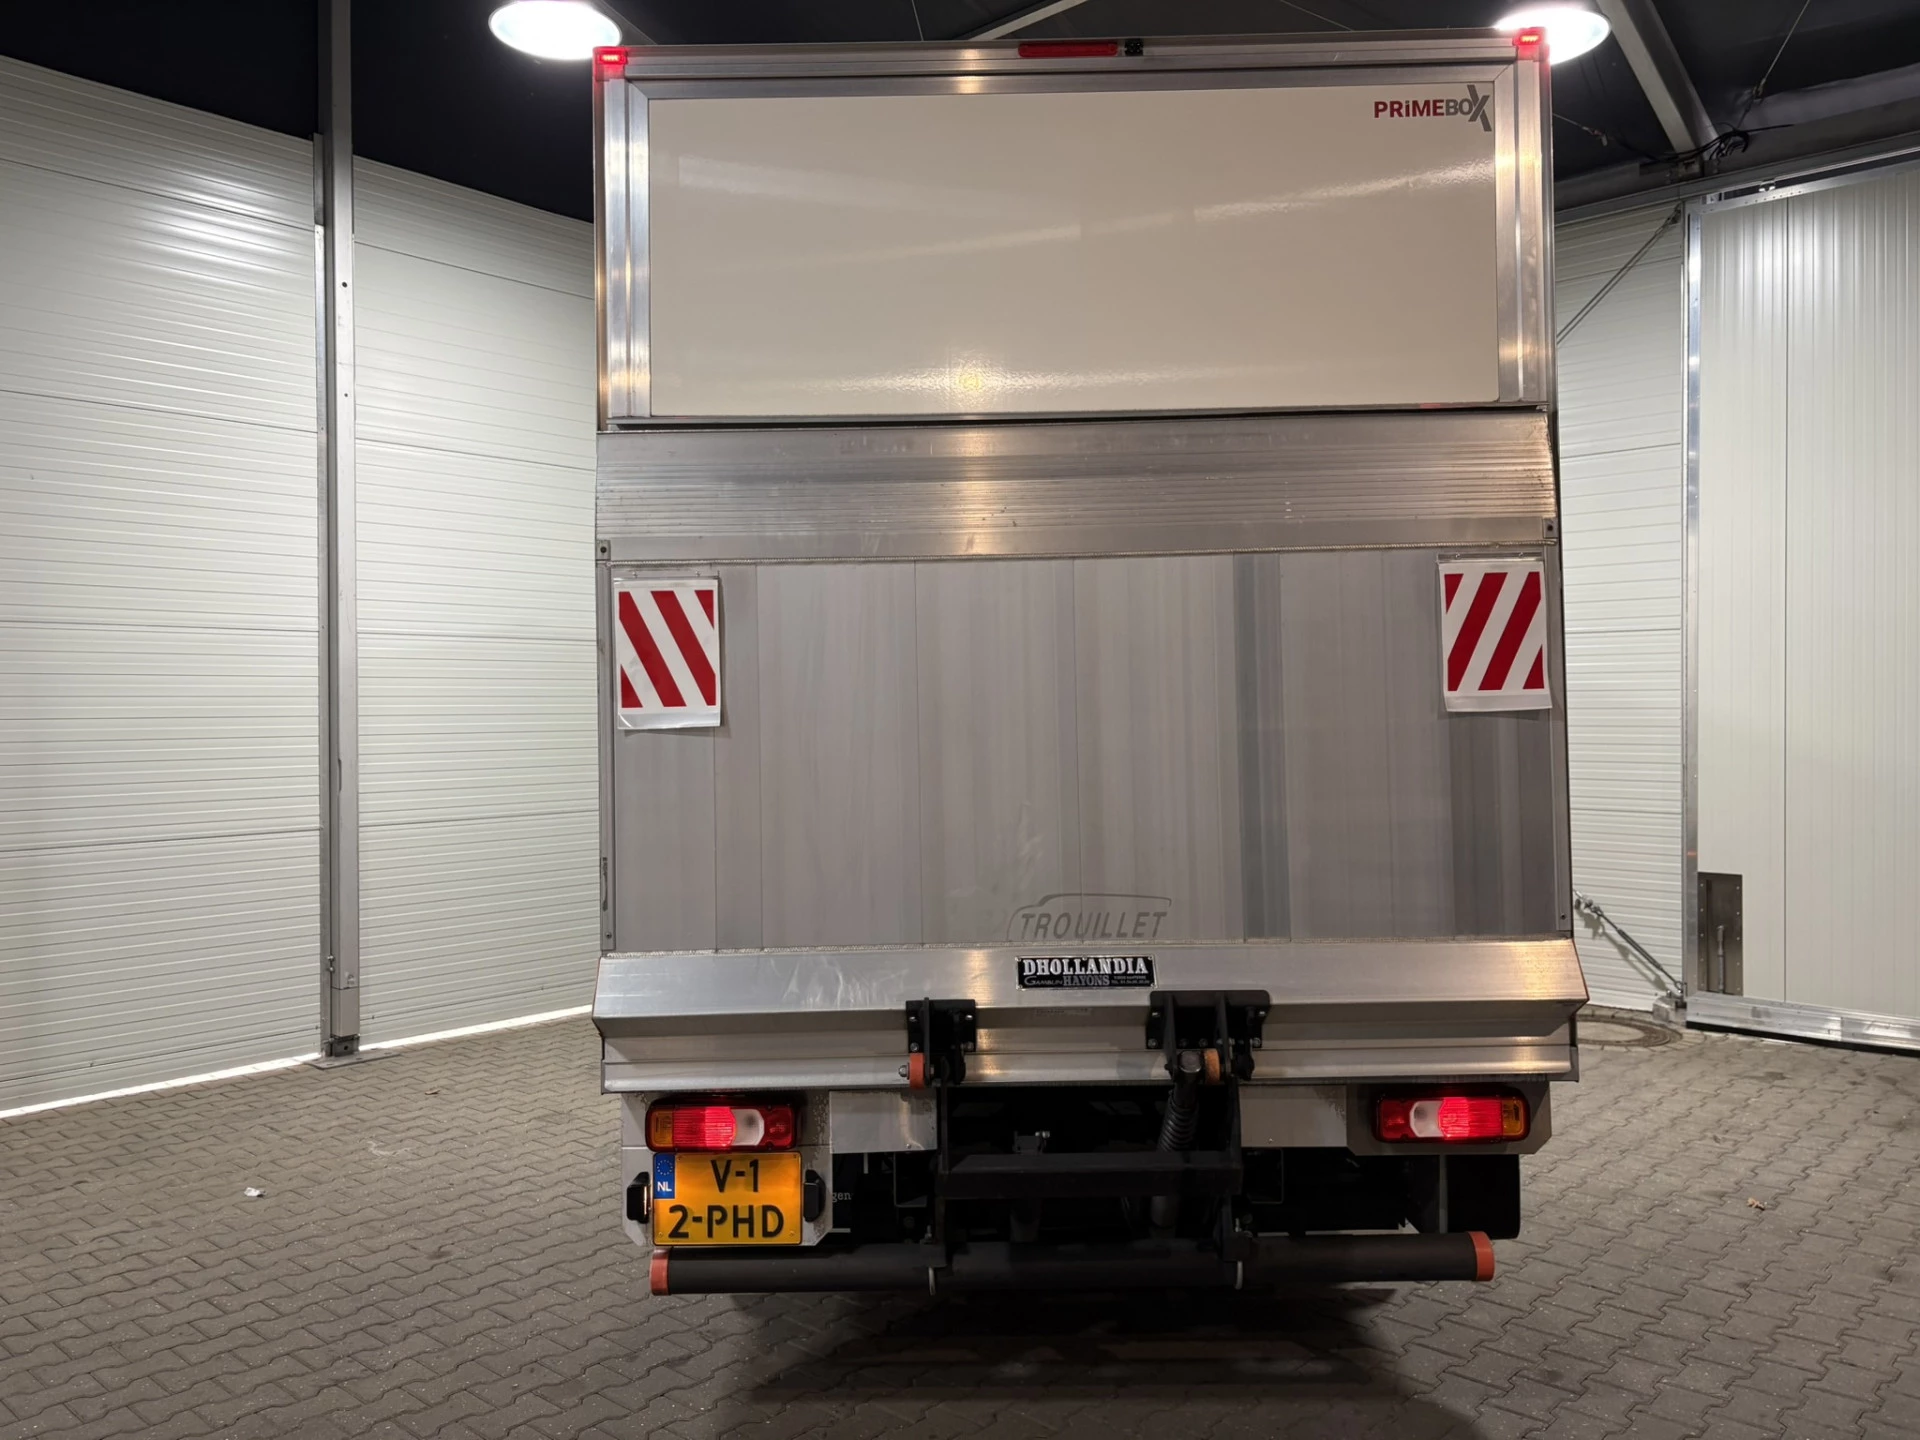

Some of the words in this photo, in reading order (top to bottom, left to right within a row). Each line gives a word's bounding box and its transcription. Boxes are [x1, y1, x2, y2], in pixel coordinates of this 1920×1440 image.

[1020, 912, 1167, 940] TROUILLET
[1023, 958, 1148, 976] DHOLLANDIA
[1062, 975, 1110, 986] HAYONS
[657, 1181, 672, 1192] NL
[710, 1159, 760, 1193] V-1
[668, 1204, 785, 1239] 2-PHD
